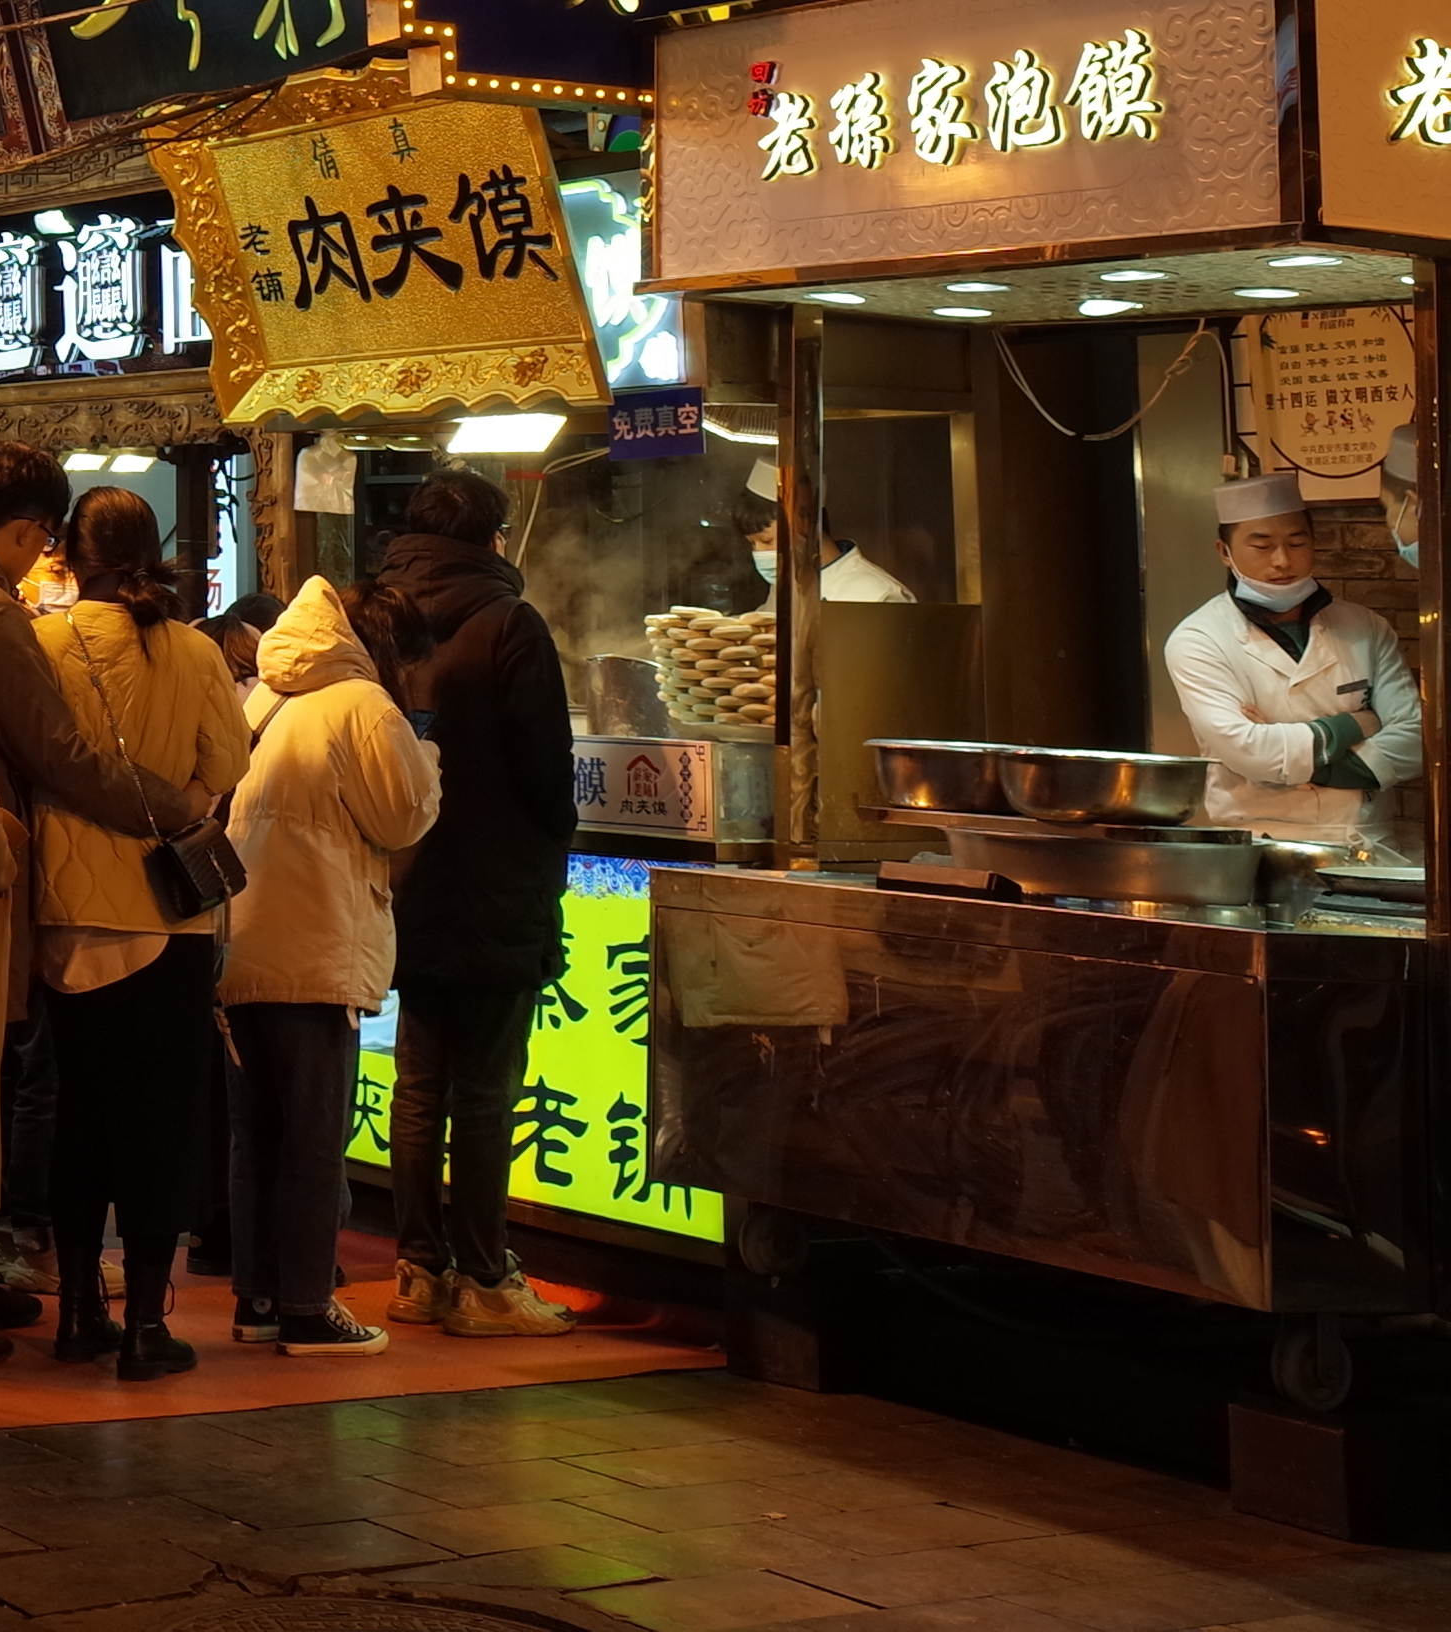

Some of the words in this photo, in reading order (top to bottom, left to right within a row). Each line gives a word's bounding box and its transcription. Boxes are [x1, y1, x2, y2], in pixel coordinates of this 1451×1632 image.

[748, 61, 779, 118] 回坊
[311, 118, 420, 181] 清真
[239, 221, 285, 303] 老铺
[287, 164, 559, 312] 肉夹馍
[1325, 382, 1415, 406] 做文明西安人
[612, 404, 700, 442] 免费真空
[619, 798, 668, 817] 肉夹馍
